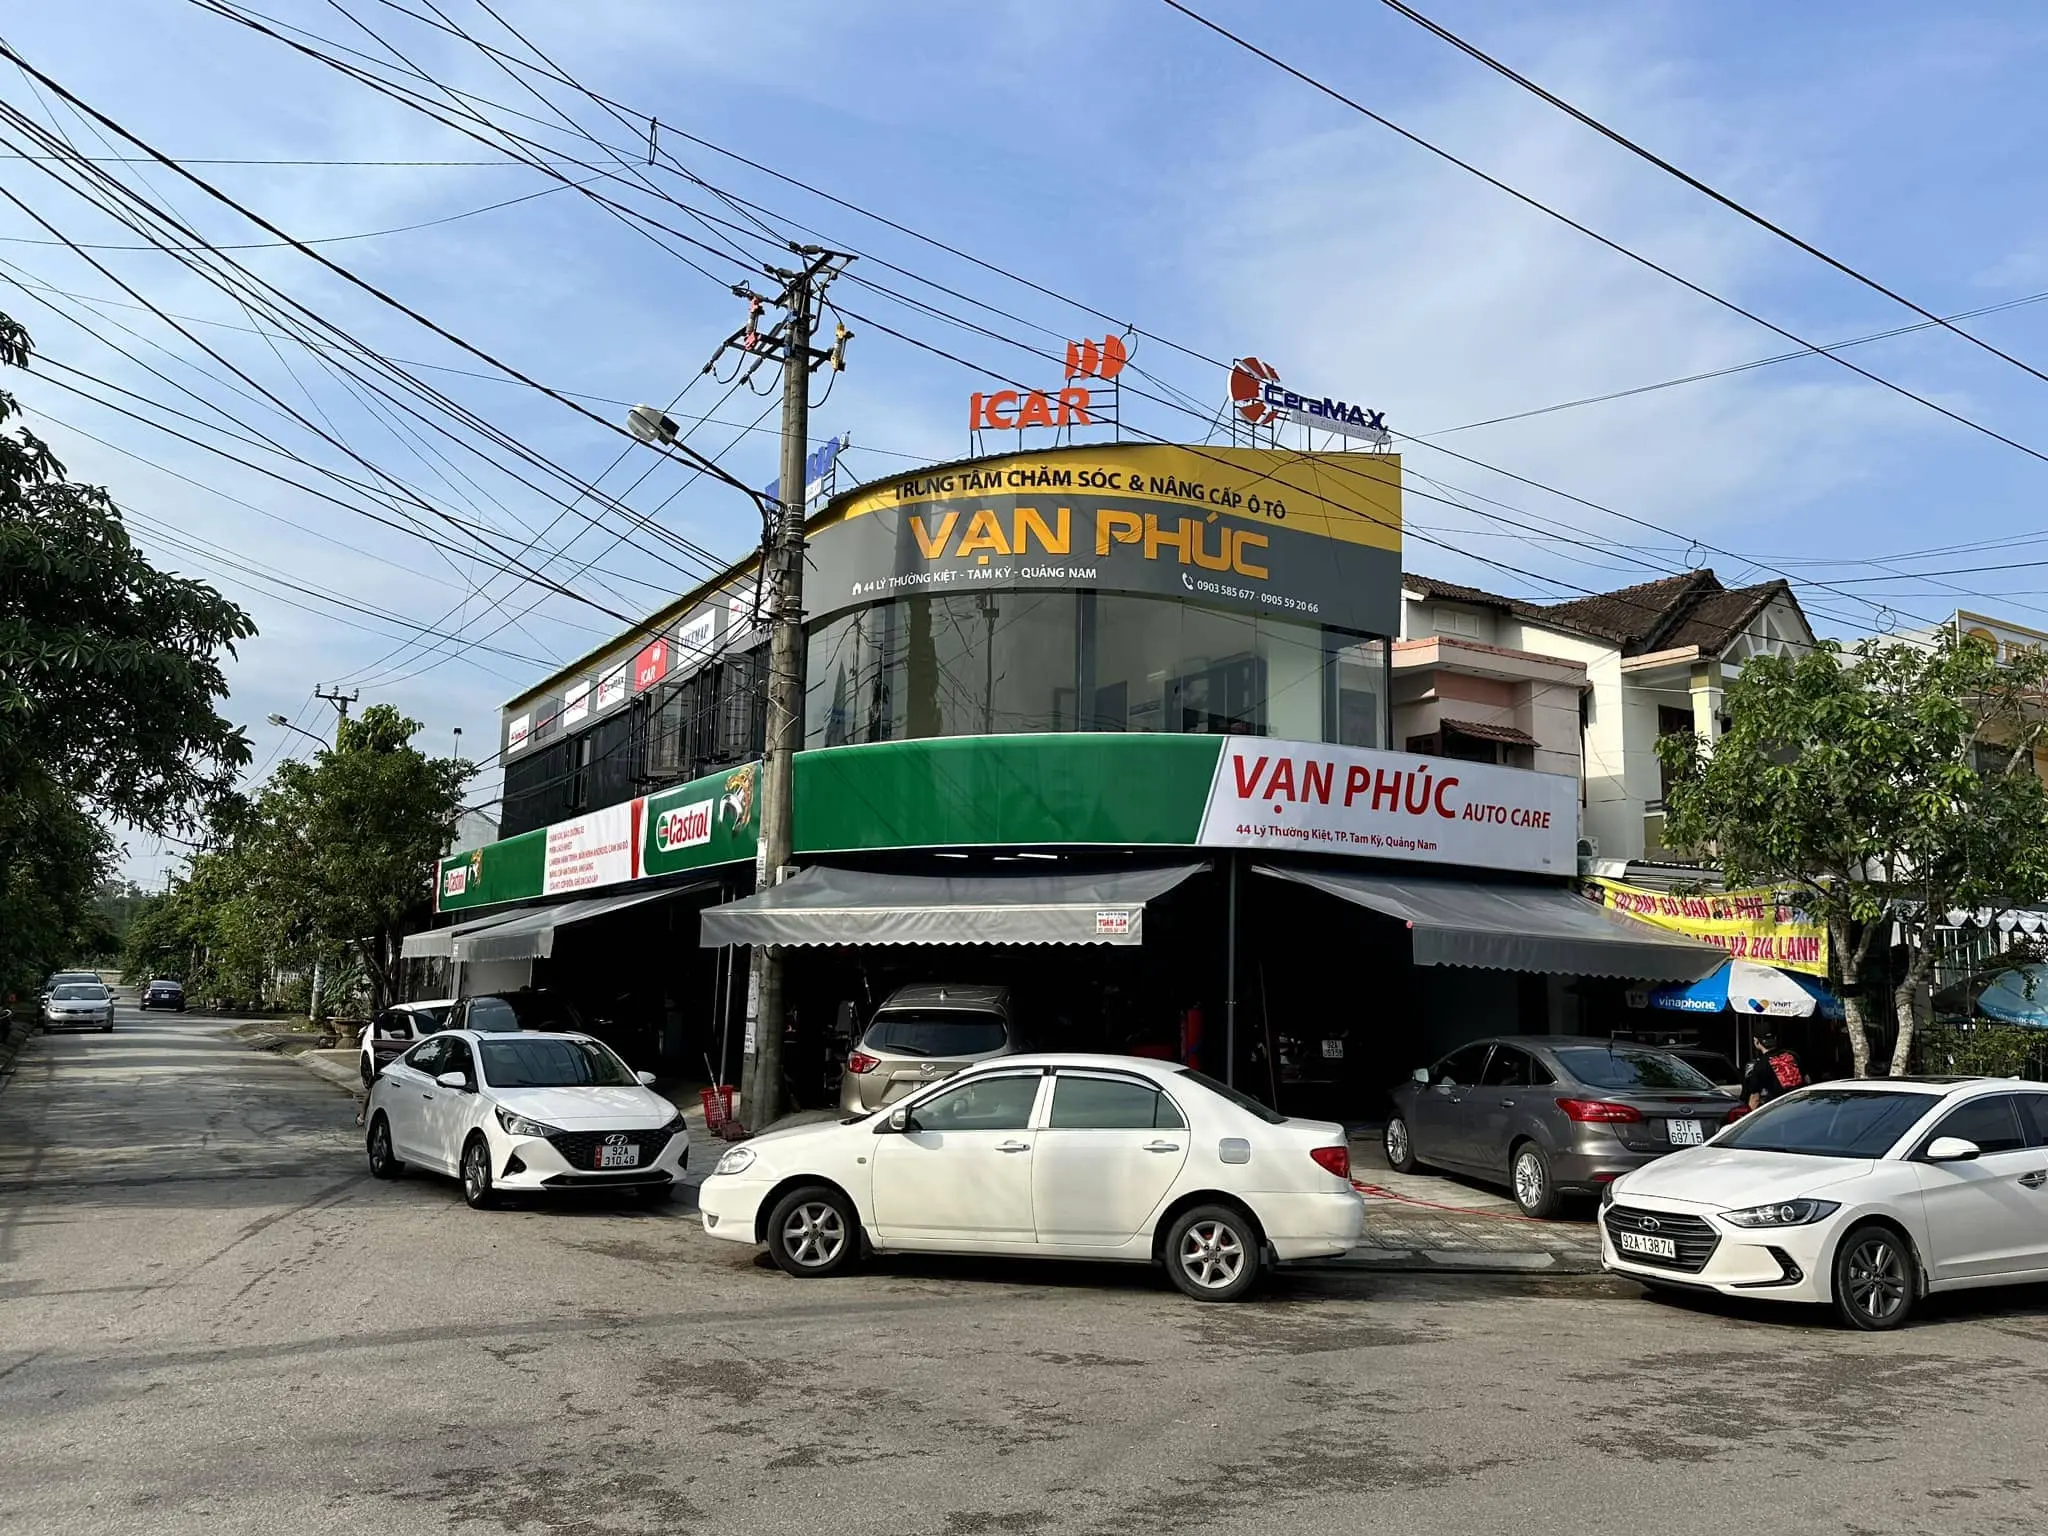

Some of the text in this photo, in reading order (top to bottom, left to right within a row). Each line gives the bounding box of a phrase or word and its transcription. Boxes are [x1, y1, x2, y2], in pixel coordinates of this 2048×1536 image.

[970, 387, 1091, 431] ICAR
[895, 466, 1286, 519] TRUNG TÂM CHĂM SÓC & NÂNG CẤP Ô TÔ
[908, 507, 1269, 581] VẠN PHÚC
[863, 582, 874, 592] 44
[888, 572, 931, 589] THƯỜNG
[933, 570, 957, 586] KIỆT
[967, 568, 992, 581] TAM
[1021, 564, 1064, 579] QUẢNG
[1068, 568, 1097, 579] NAM
[1197, 580, 1219, 594] 0903
[1221, 585, 1237, 597] 585
[1238, 589, 1255, 601] 677
[1261, 593, 1282, 606] 0905
[1284, 598, 1295, 608] 59
[1296, 600, 1306, 611] 20
[1307, 603, 1319, 613] 66
[1233, 754, 1551, 829] VẠN PHÚC AUTO CARE
[669, 805, 709, 845] Castrol
[1236, 824, 1251, 834] 44
[1253, 824, 1266, 837] Lý
[1268, 825, 1309, 841] Thường
[1311, 829, 1333, 843] Kiệt,
[1335, 831, 1348, 842] TP.
[1349, 832, 1369, 844] Tam
[1385, 836, 1416, 851] Quảng
[1417, 839, 1437, 850] Nam
[1750, 936, 1775, 959] BIA
[1777, 936, 1820, 965] LẠNH
[1659, 996, 1716, 1011] vinaphone
[1675, 1120, 1692, 1132] 51F
[612, 1146, 629, 1156] 92A
